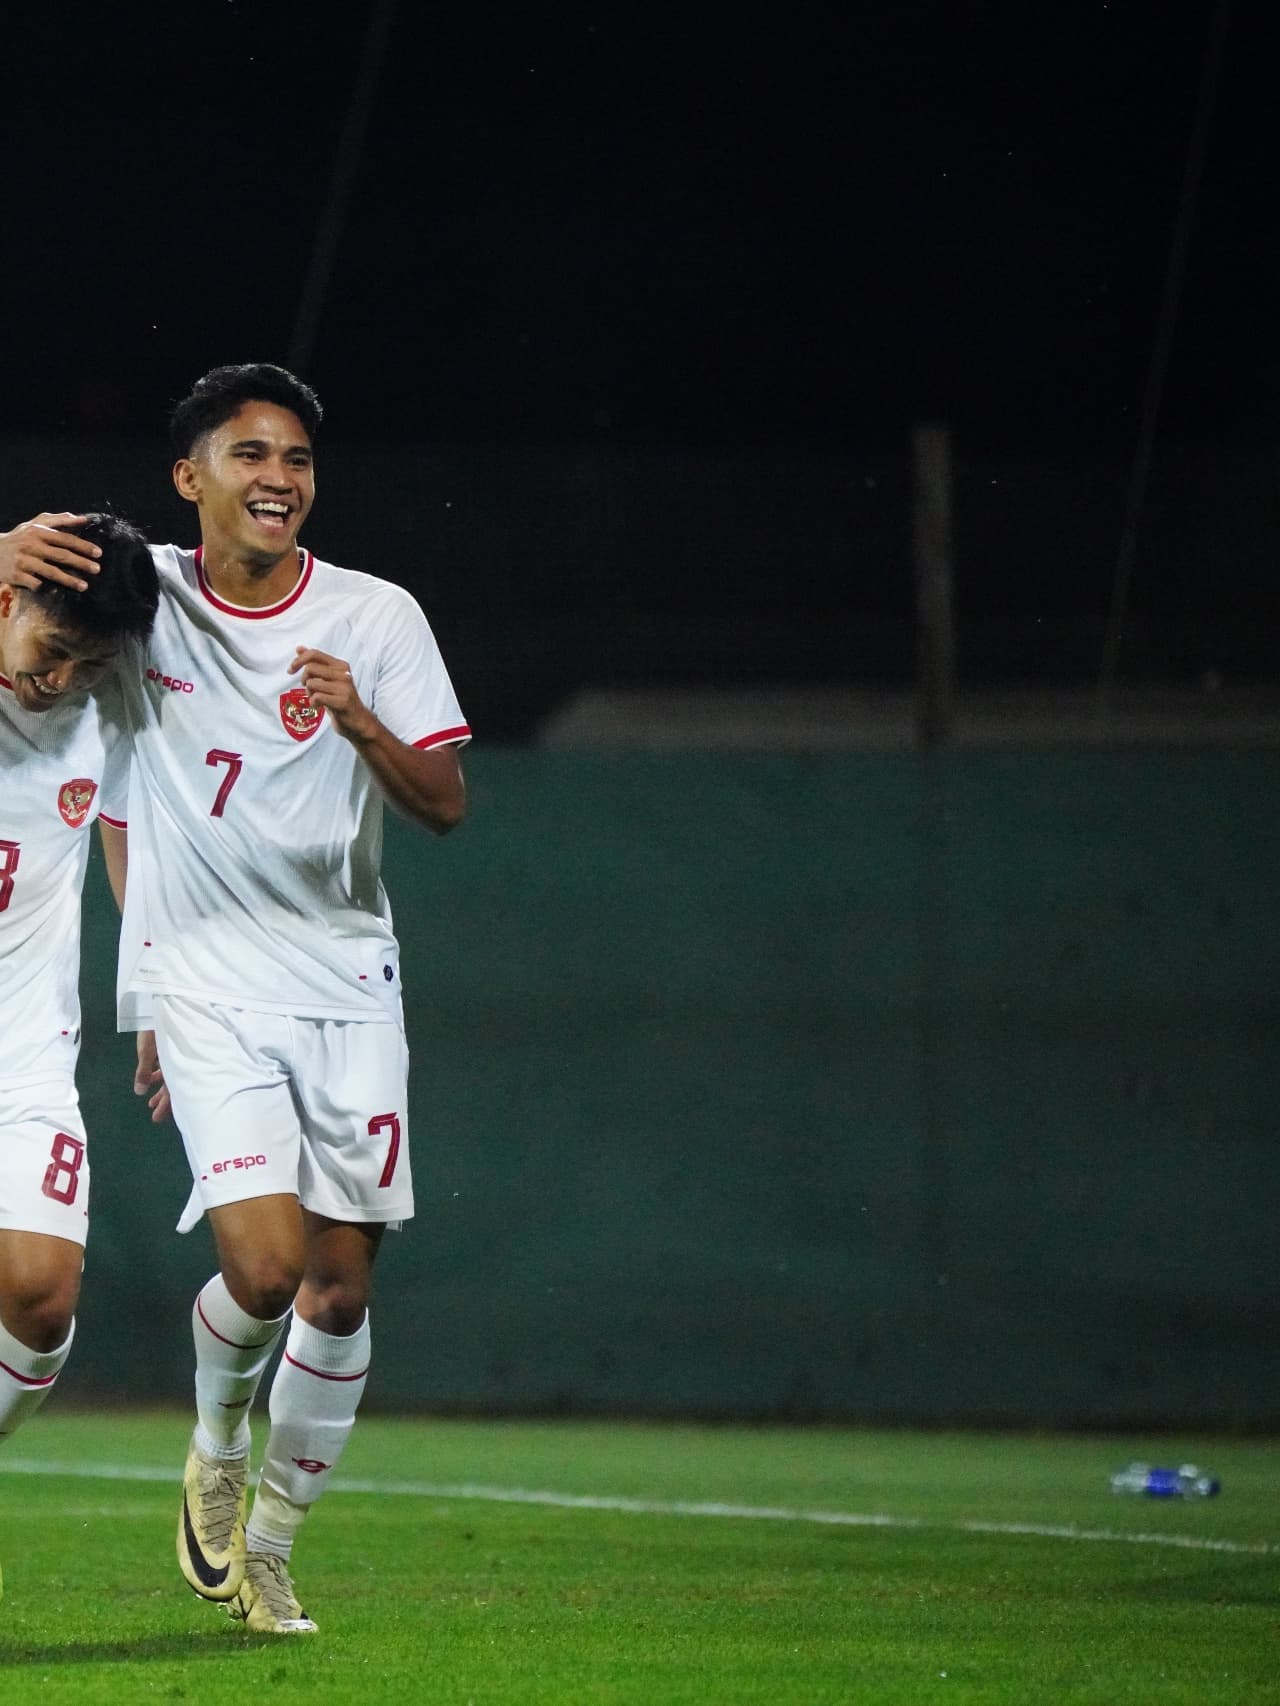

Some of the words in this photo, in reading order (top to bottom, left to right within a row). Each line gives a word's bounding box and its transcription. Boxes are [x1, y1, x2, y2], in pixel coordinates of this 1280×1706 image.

[146, 668, 195, 693] erspo
[205, 748, 243, 818] 7
[41, 1132, 86, 1206] 8
[212, 1153, 268, 1175] erspo
[367, 1111, 401, 1189] 7
